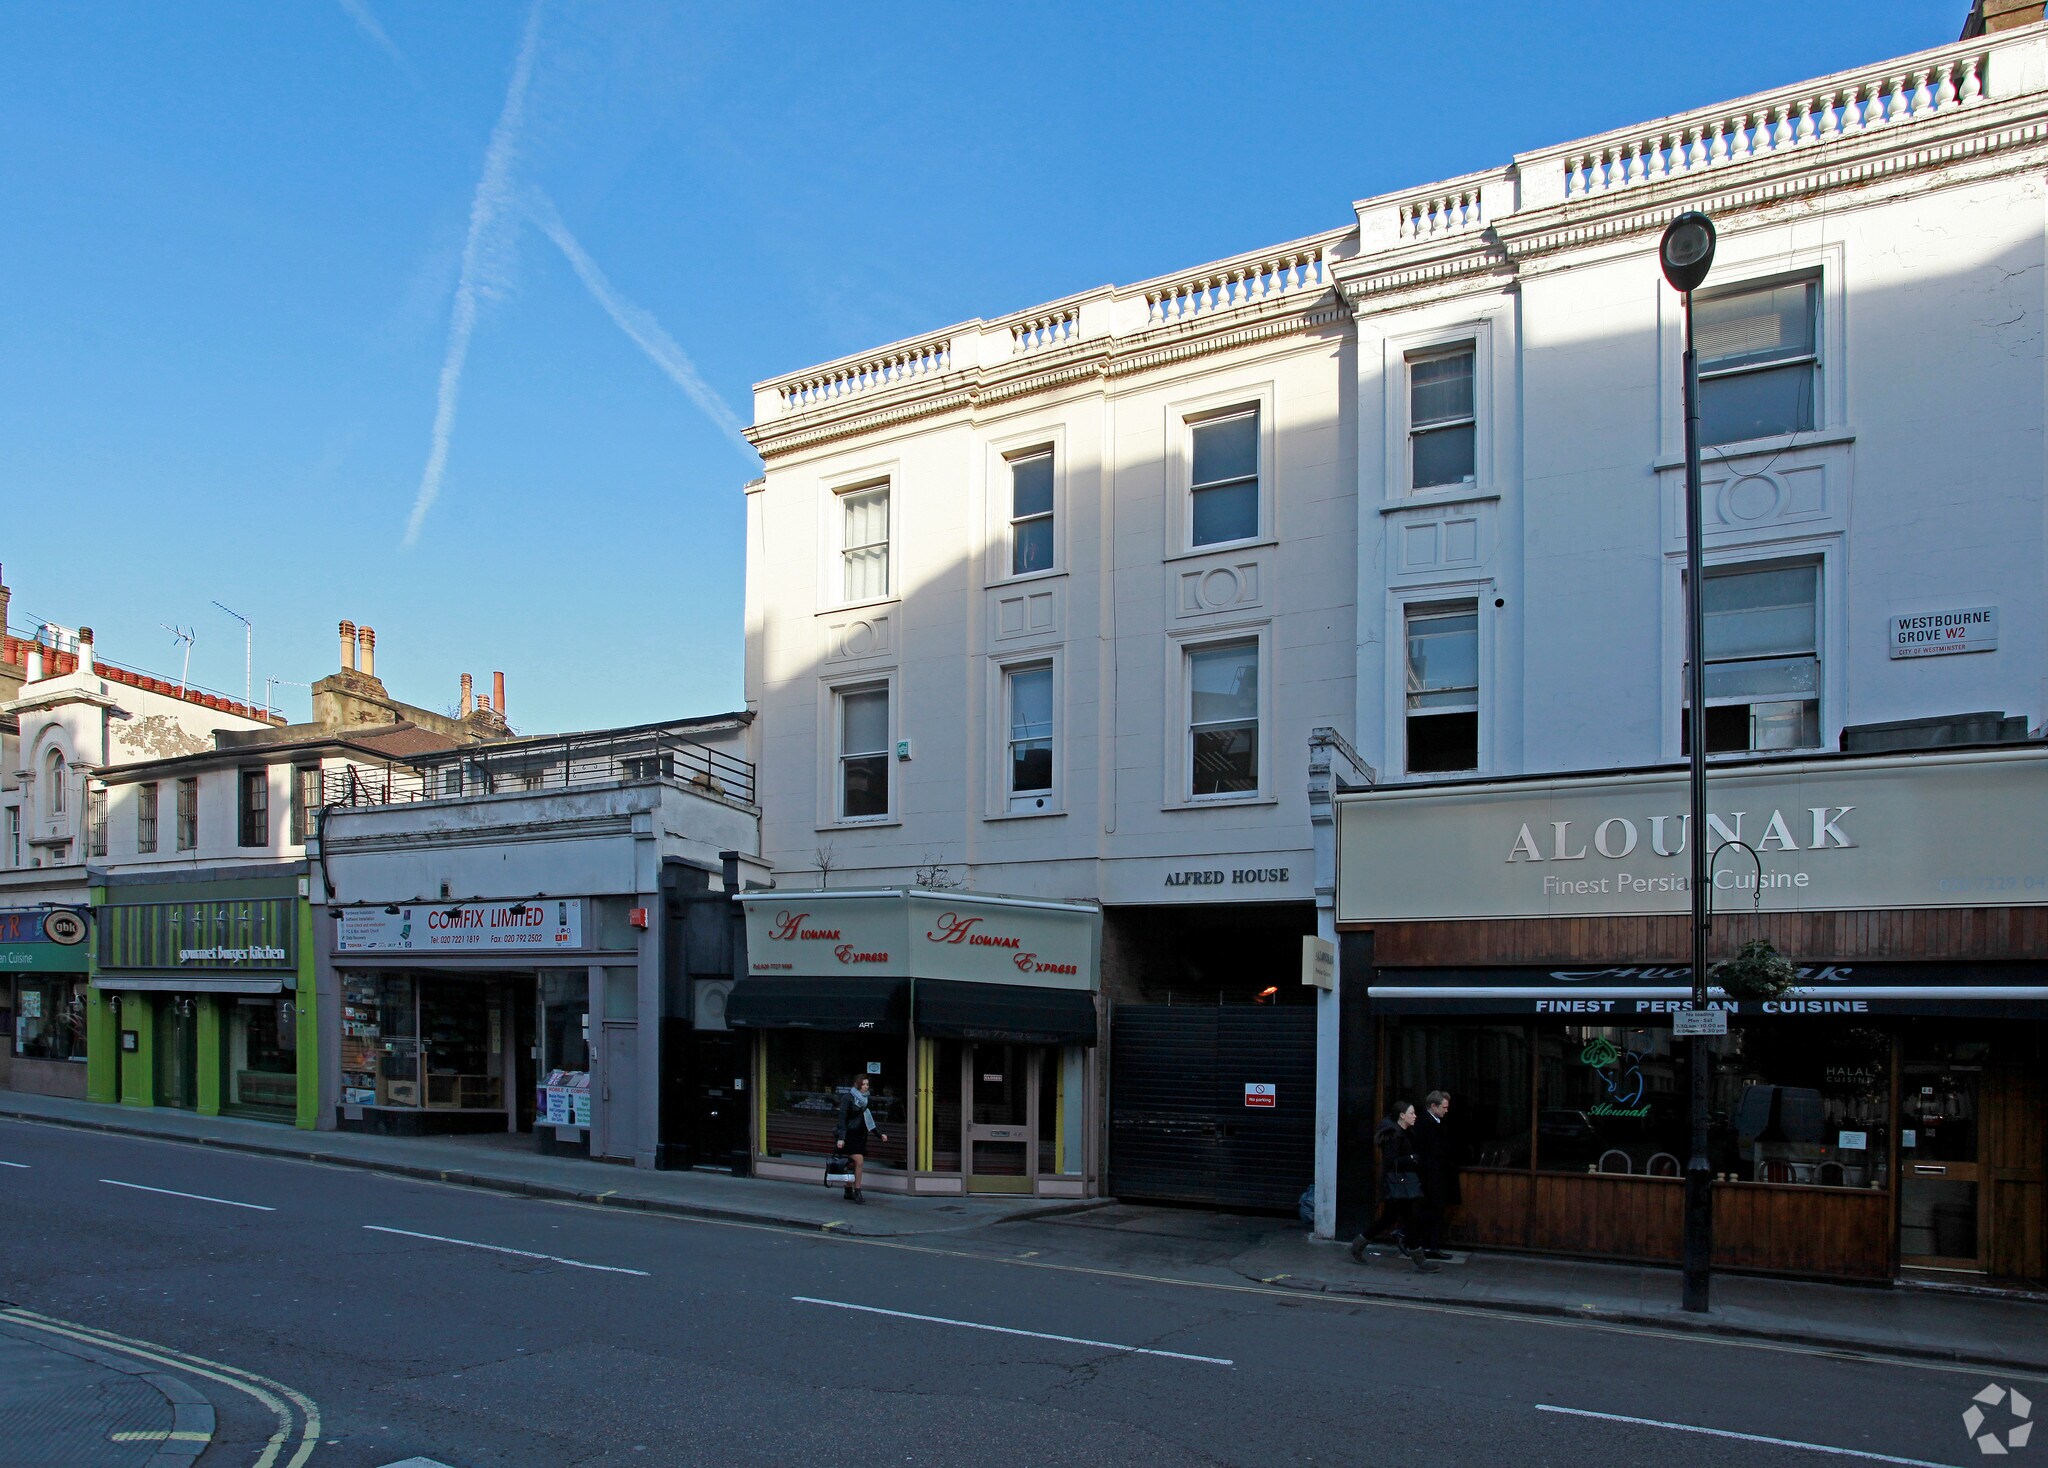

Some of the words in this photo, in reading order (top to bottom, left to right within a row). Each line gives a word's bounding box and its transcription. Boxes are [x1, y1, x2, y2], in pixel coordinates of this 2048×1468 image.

[1899, 611, 1991, 630] WESTBOURNE
[1898, 629, 1941, 643] GROVE
[1945, 627, 1965, 639] W2
[1923, 645, 1966, 653] WESTMINSTER
[1505, 806, 1859, 863] ALOUNAK
[1165, 870, 1225, 886] ALFRED
[1231, 868, 1289, 884] HOUSE
[1543, 875, 1609, 895] Finest
[1617, 872, 1692, 892] Persia
[1713, 868, 1810, 890] Cuisine
[428, 908, 485, 930] COMFIX
[490, 907, 544, 928] LIMITED
[56, 922, 76, 933] gbk
[440, 936, 450, 944] 020
[504, 934, 514, 943] 020
[8, 952, 32, 964] Cuisine
[180, 948, 218, 963] gourmet
[218, 946, 249, 963] burger
[250, 945, 285, 960] kitchen
[1536, 1001, 1615, 1012] FINEST
[1636, 1001, 1739, 1013] PERSAN
[1762, 1001, 1868, 1013] CUISINE
[1826, 1066, 1871, 1076] HALAL
[1588, 1102, 1652, 1117] Alounak
